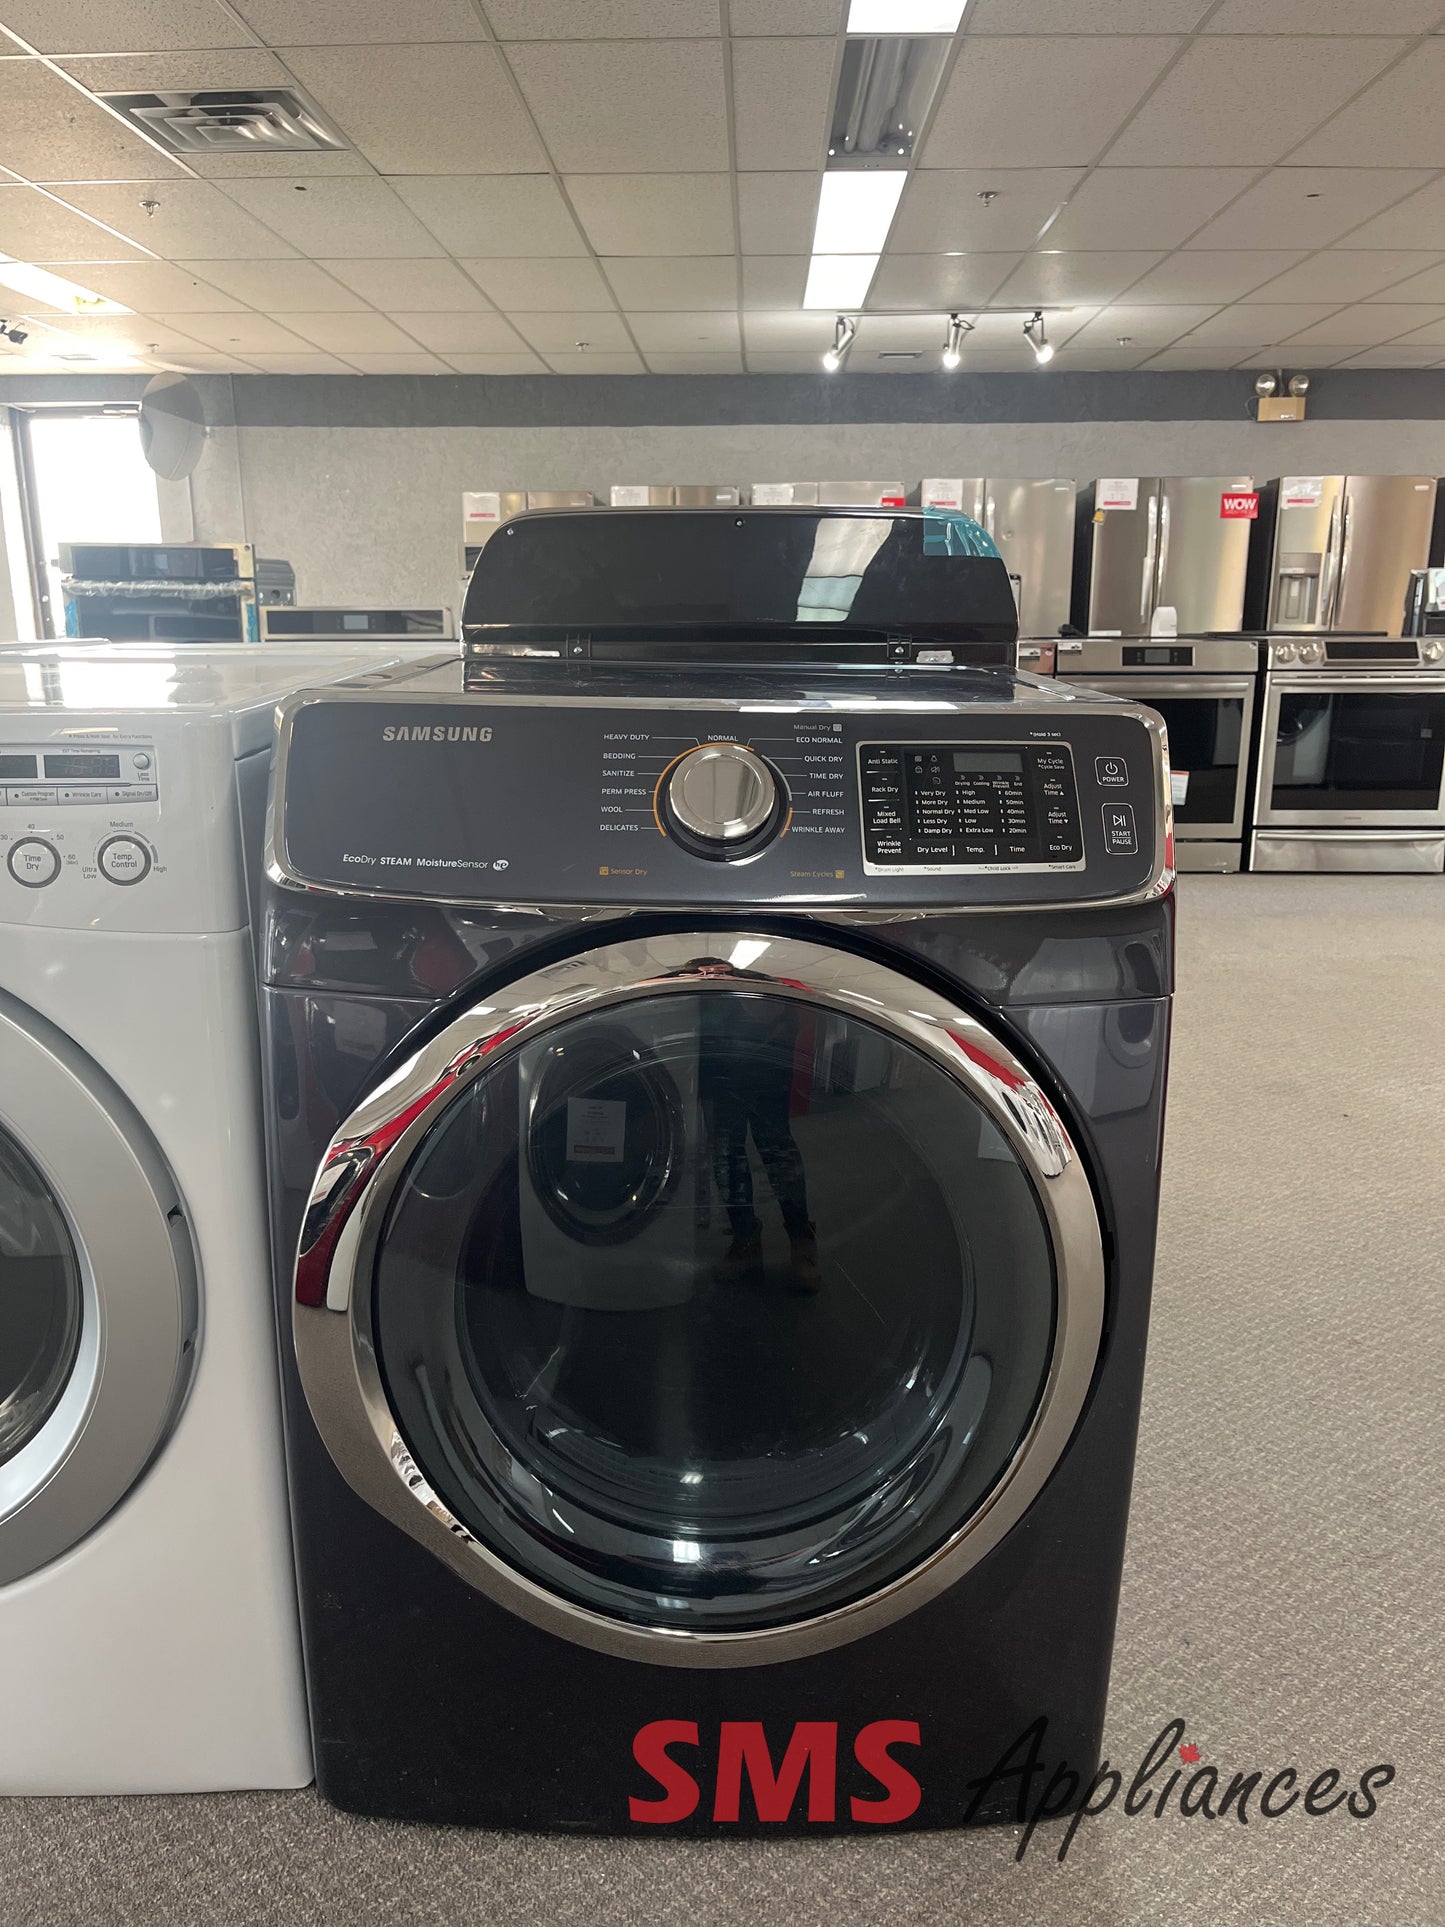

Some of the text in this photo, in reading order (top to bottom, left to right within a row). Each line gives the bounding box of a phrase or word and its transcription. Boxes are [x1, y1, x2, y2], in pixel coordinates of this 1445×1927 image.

[1224, 498, 1257, 510] WOW
[382, 726, 493, 742] SAMSUNG
[113, 853, 134, 861] Temp.
[343, 853, 377, 865] EcoDry
[380, 856, 412, 866] STEAM
[416, 858, 488, 869] MoistureSensor
[26, 863, 39, 871] Dry
[111, 860, 138, 868] Control
[635, 868, 647, 876] Dry
